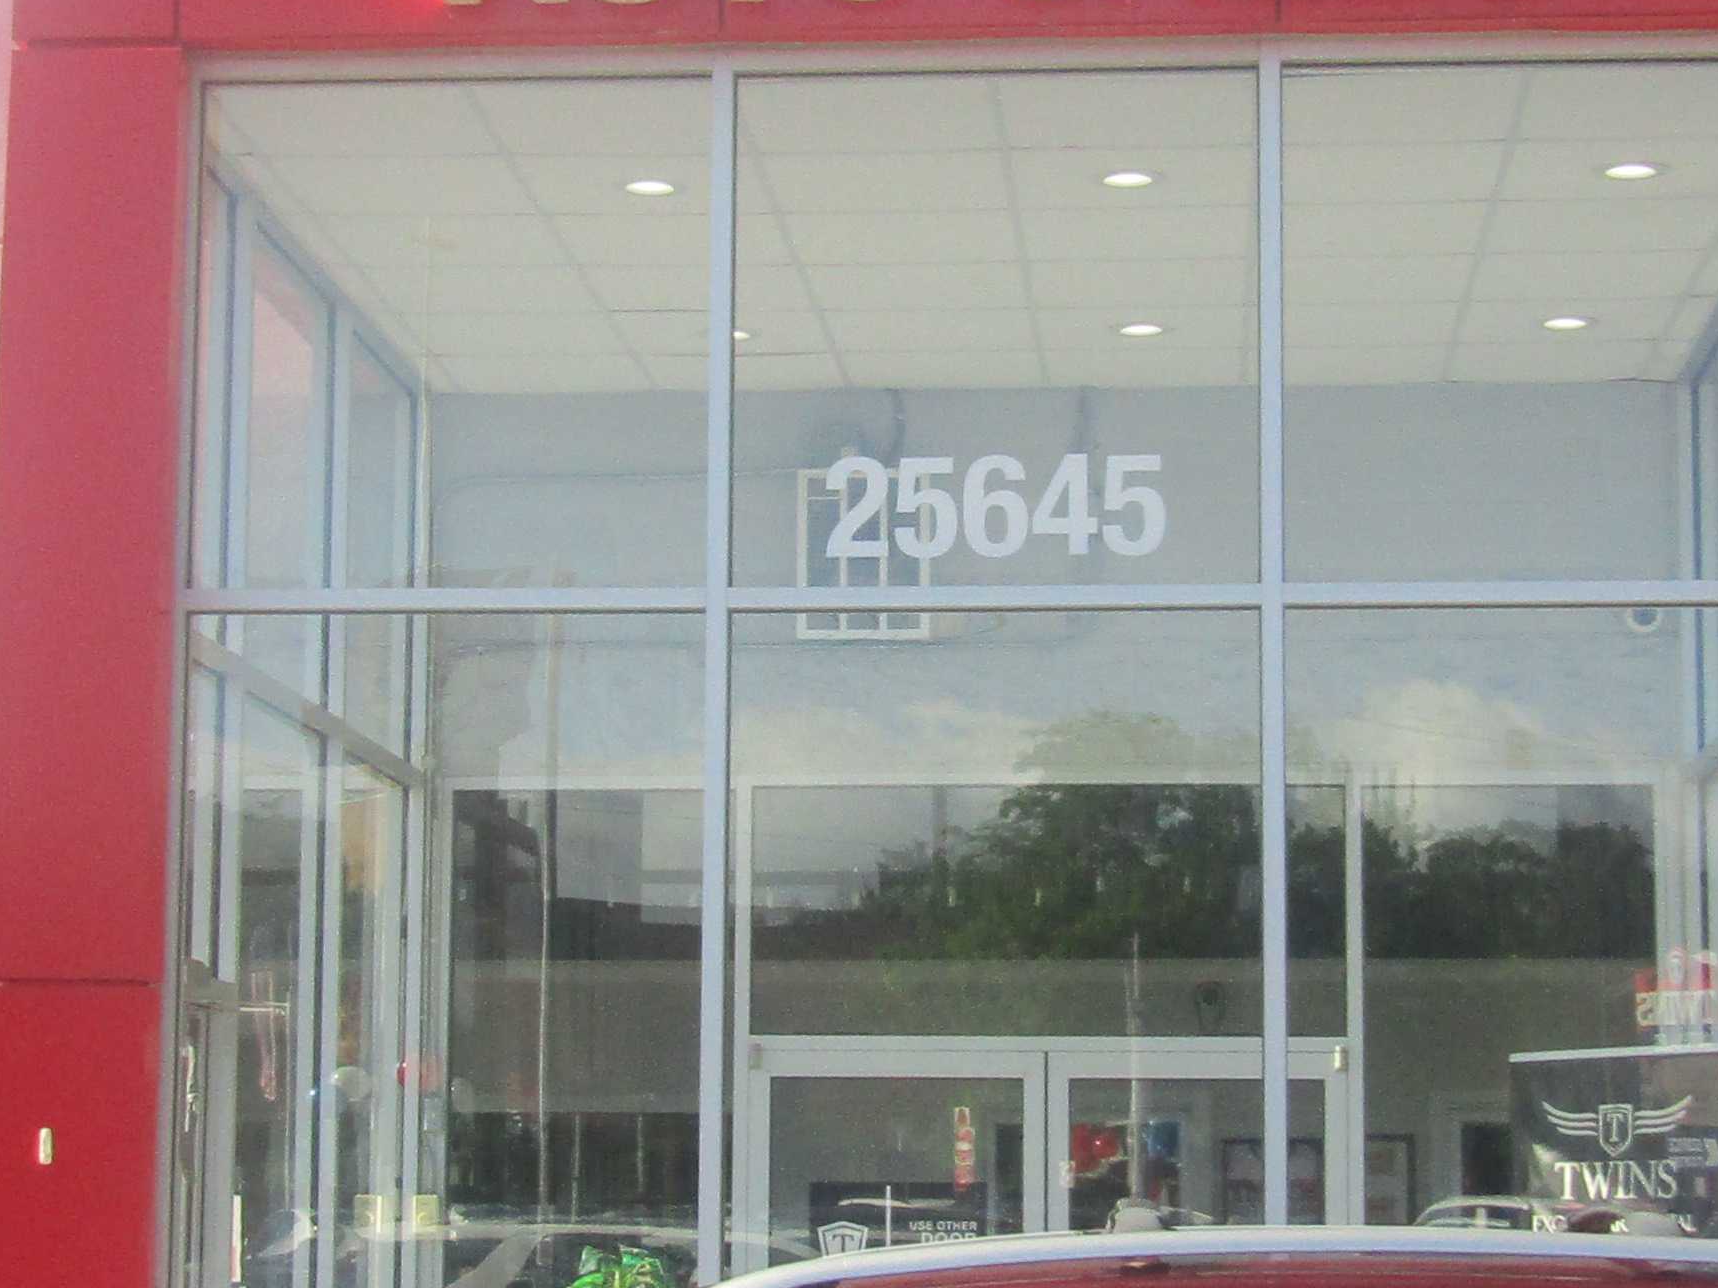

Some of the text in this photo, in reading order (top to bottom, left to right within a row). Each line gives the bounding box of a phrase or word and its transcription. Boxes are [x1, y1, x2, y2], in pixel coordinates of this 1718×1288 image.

[824, 452, 1167, 559] 25645
[1554, 1159, 1678, 1200] TWINS
[909, 1220, 978, 1231] USE OTHER
